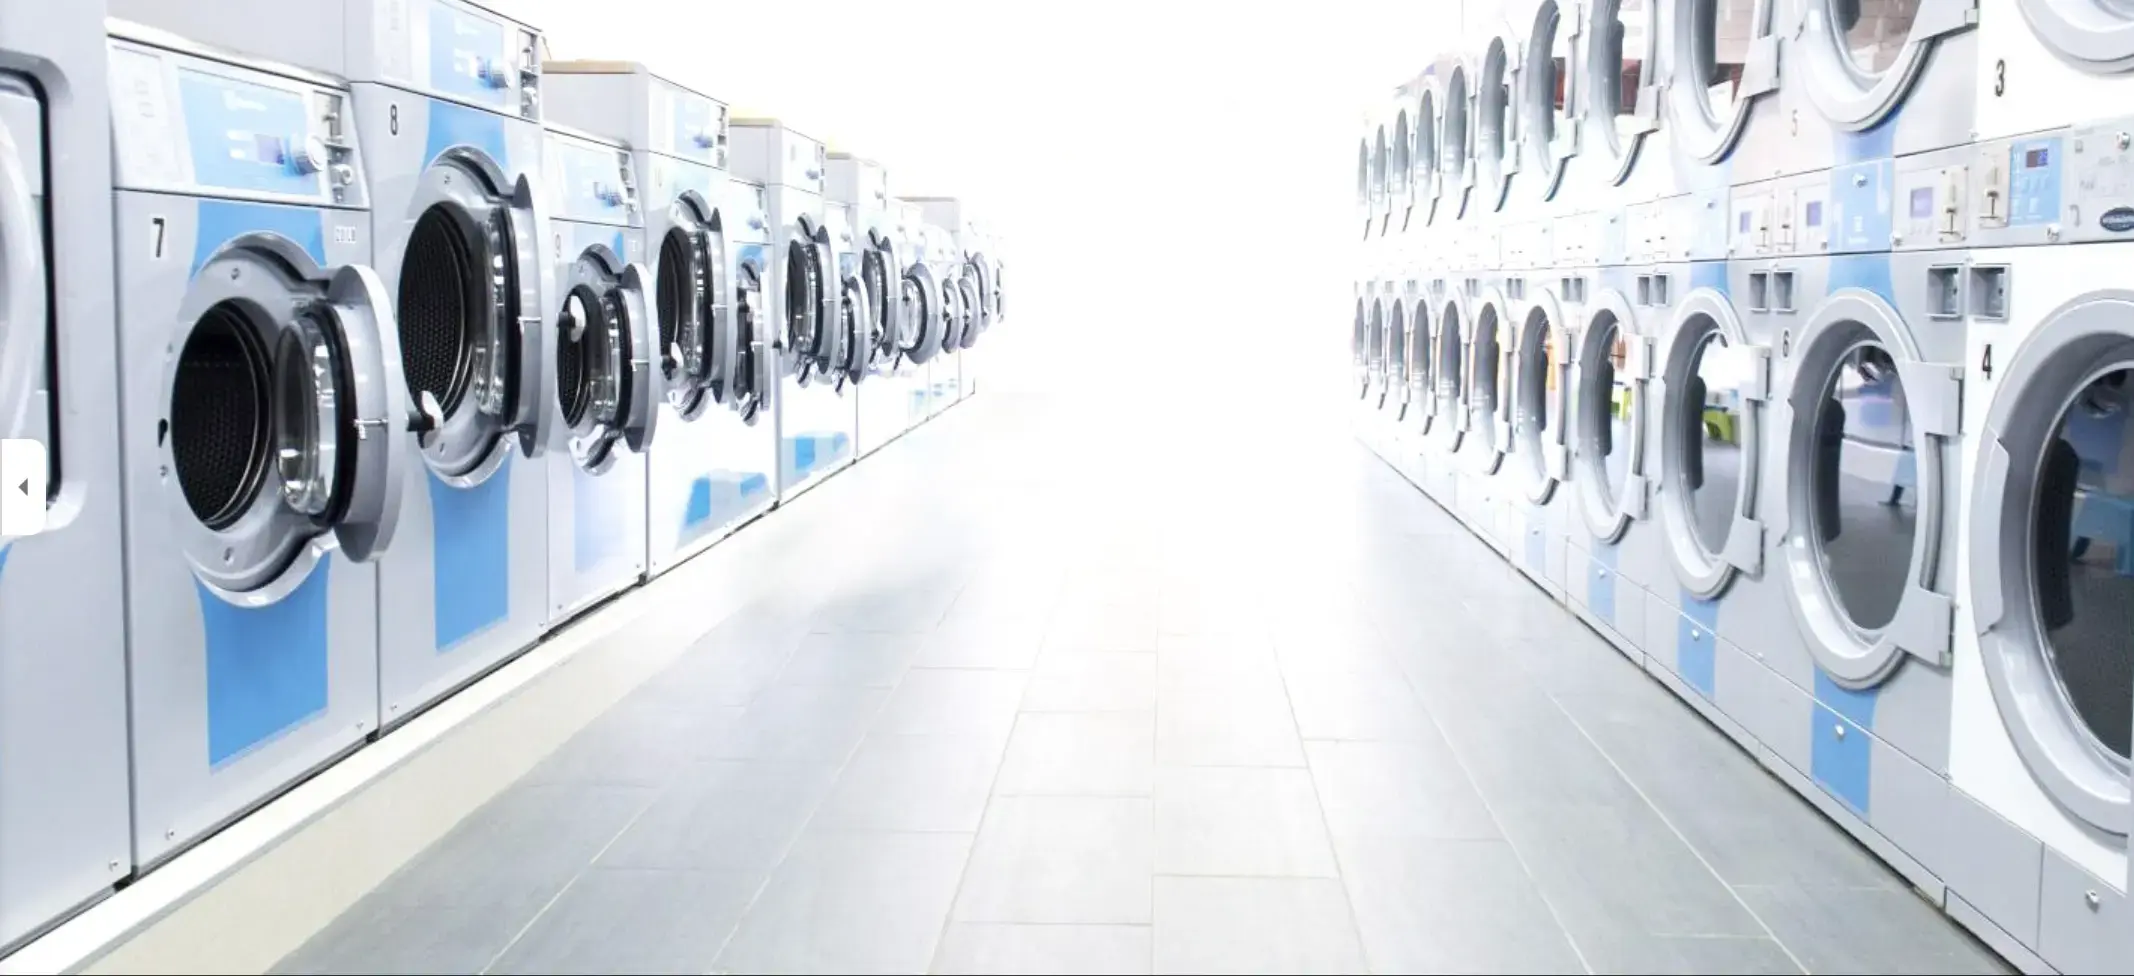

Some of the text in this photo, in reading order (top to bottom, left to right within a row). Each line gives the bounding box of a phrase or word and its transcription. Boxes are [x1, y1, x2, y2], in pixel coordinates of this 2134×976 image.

[1995, 58, 2005, 97] 3
[390, 103, 398, 136] 8
[152, 217, 165, 258] 7
[1782, 329, 1790, 358] 6
[1982, 343, 1992, 380] 4
